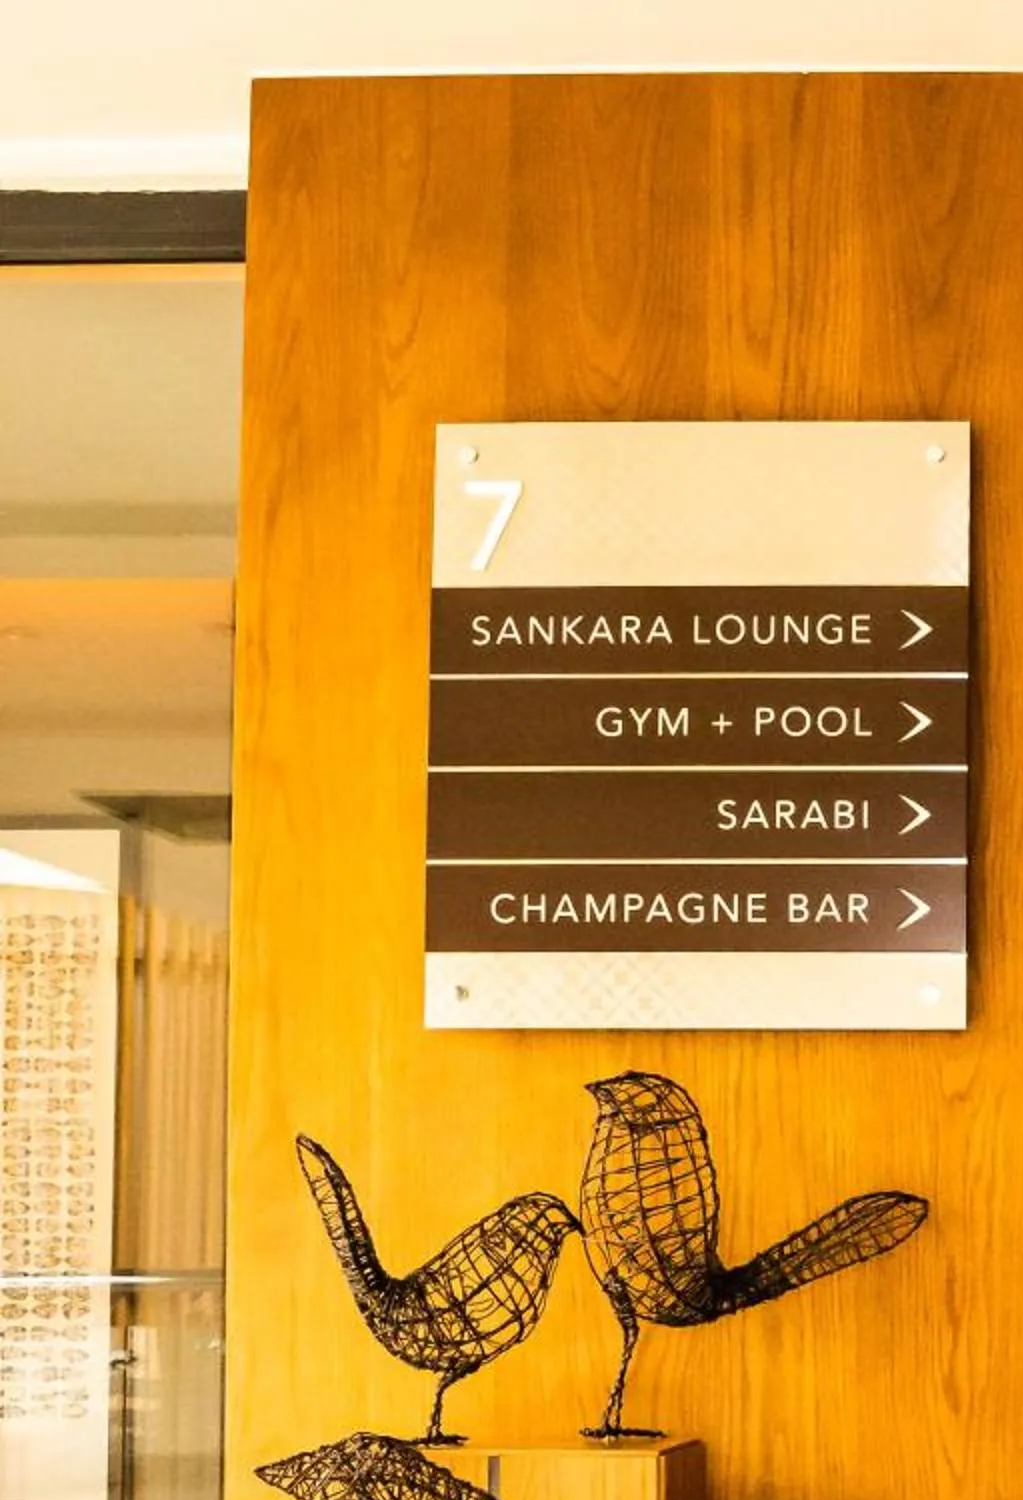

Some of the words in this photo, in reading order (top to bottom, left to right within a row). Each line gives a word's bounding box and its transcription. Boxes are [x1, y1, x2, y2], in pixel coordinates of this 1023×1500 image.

[461, 480, 523, 571] 7
[471, 614, 673, 646] SANKARA
[693, 613, 872, 646] LOUNGE
[595, 706, 690, 738] GYM
[711, 713, 733, 735] +
[754, 706, 873, 737] POOL
[717, 799, 870, 830] SARABI
[490, 892, 768, 924] CHAMPAGNE
[787, 892, 870, 924] BAR
